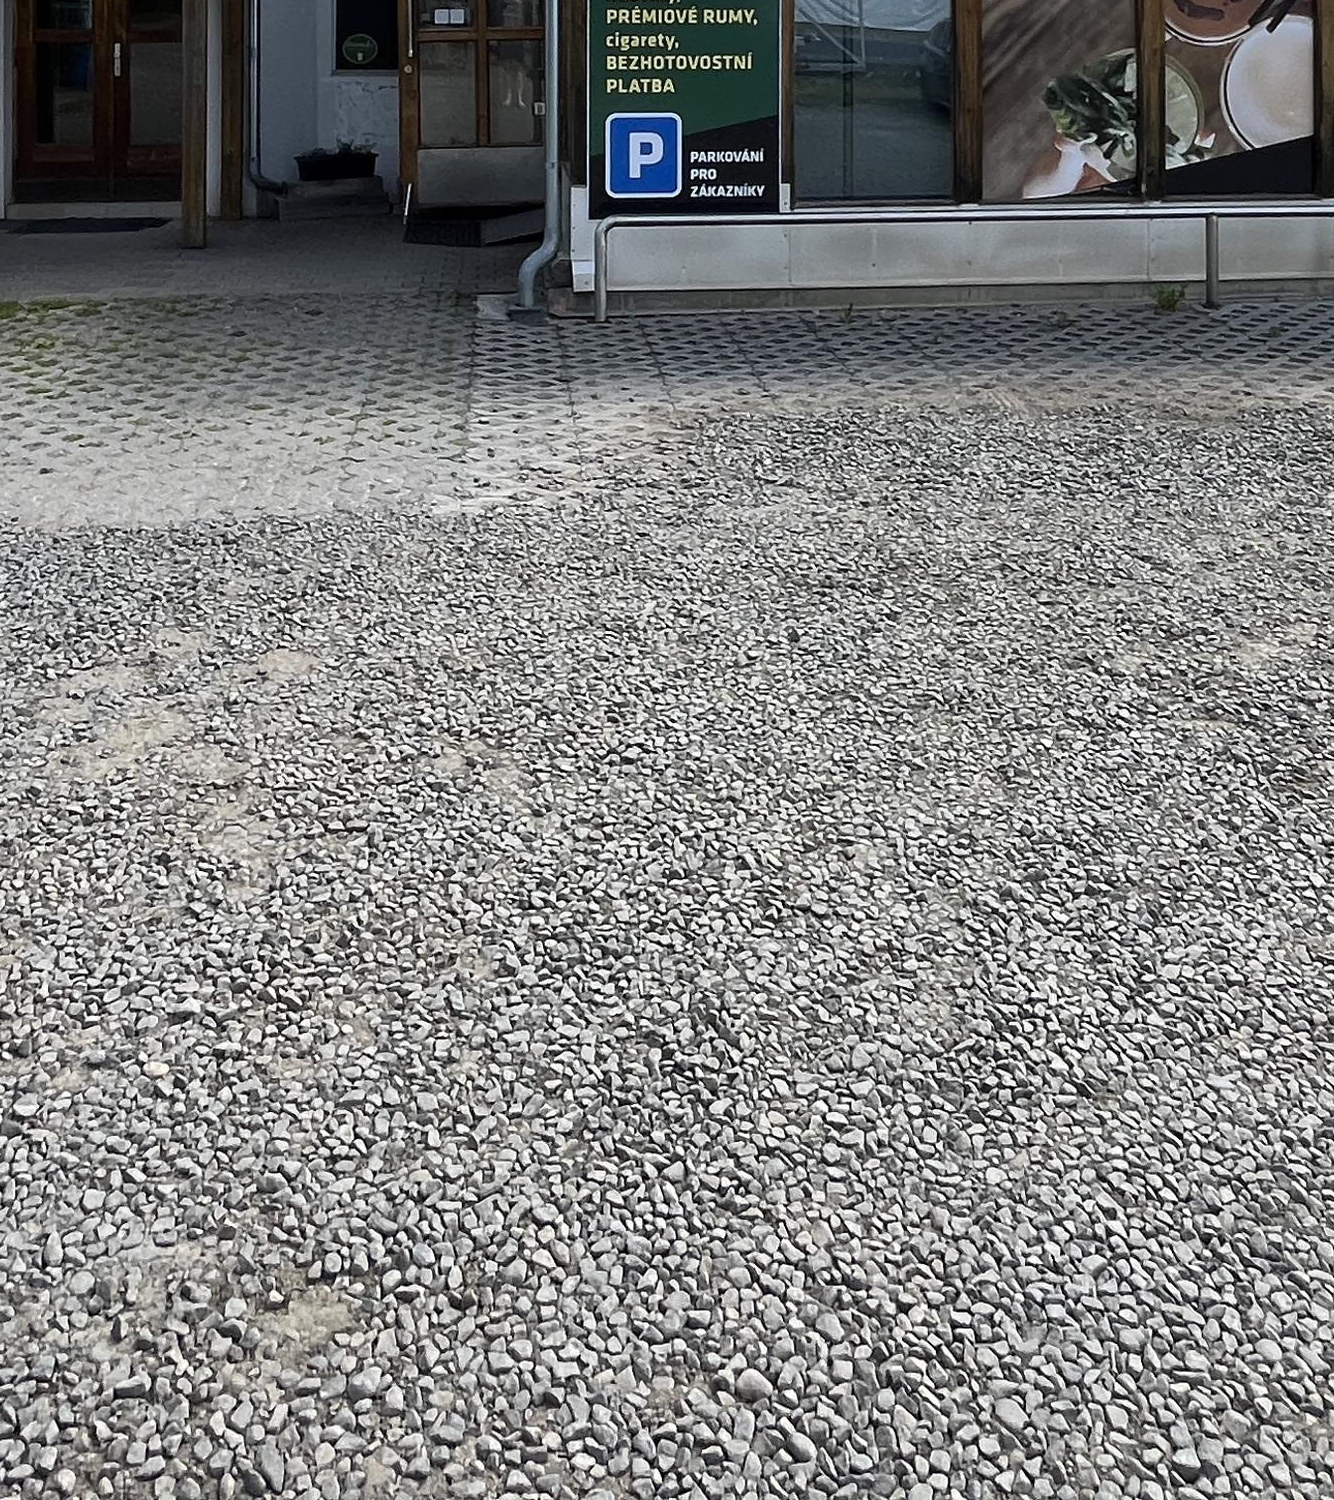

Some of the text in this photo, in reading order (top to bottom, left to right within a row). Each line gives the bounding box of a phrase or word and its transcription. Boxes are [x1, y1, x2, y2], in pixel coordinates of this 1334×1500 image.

[606, 5, 758, 26] PRÉMIOVÉ RUMY,
[606, 33, 680, 51] cigarety,
[606, 51, 753, 71] BEZHOTOVOSTNÍ
[606, 79, 675, 94] PLATBA
[628, 132, 664, 179] P
[690, 150, 764, 163] PARKOVÁNÍ
[690, 169, 717, 180] PRO
[690, 184, 765, 198] ZÁKAZNÍKY
